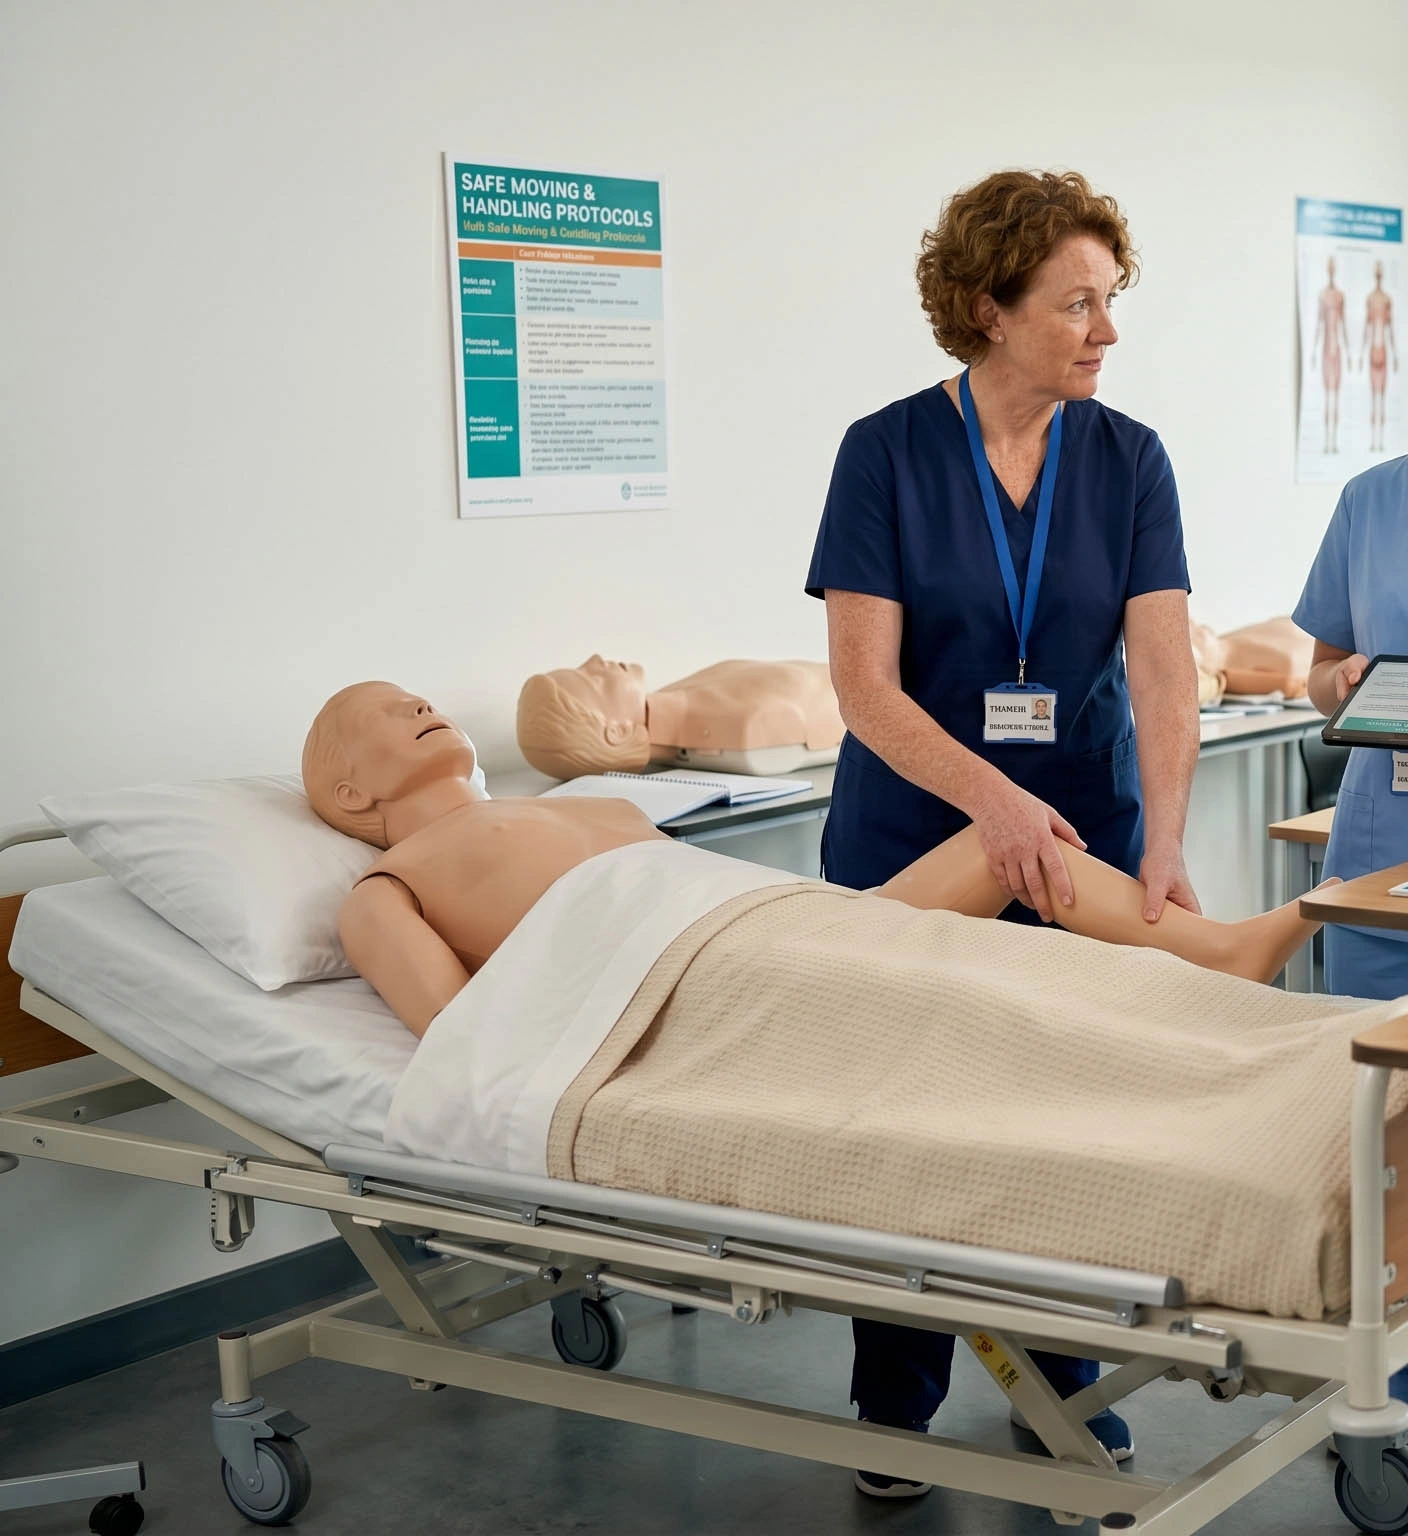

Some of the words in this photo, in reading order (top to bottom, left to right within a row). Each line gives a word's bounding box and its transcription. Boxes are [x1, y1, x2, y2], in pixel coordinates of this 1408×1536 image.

[461, 172, 507, 194] SAFE
[511, 176, 580, 200] MOVING
[583, 183, 596, 201] &
[462, 196, 552, 220] HANDLING
[556, 203, 654, 228] PROTOCOLS
[487, 221, 510, 234] Safe
[512, 223, 548, 239] Moving
